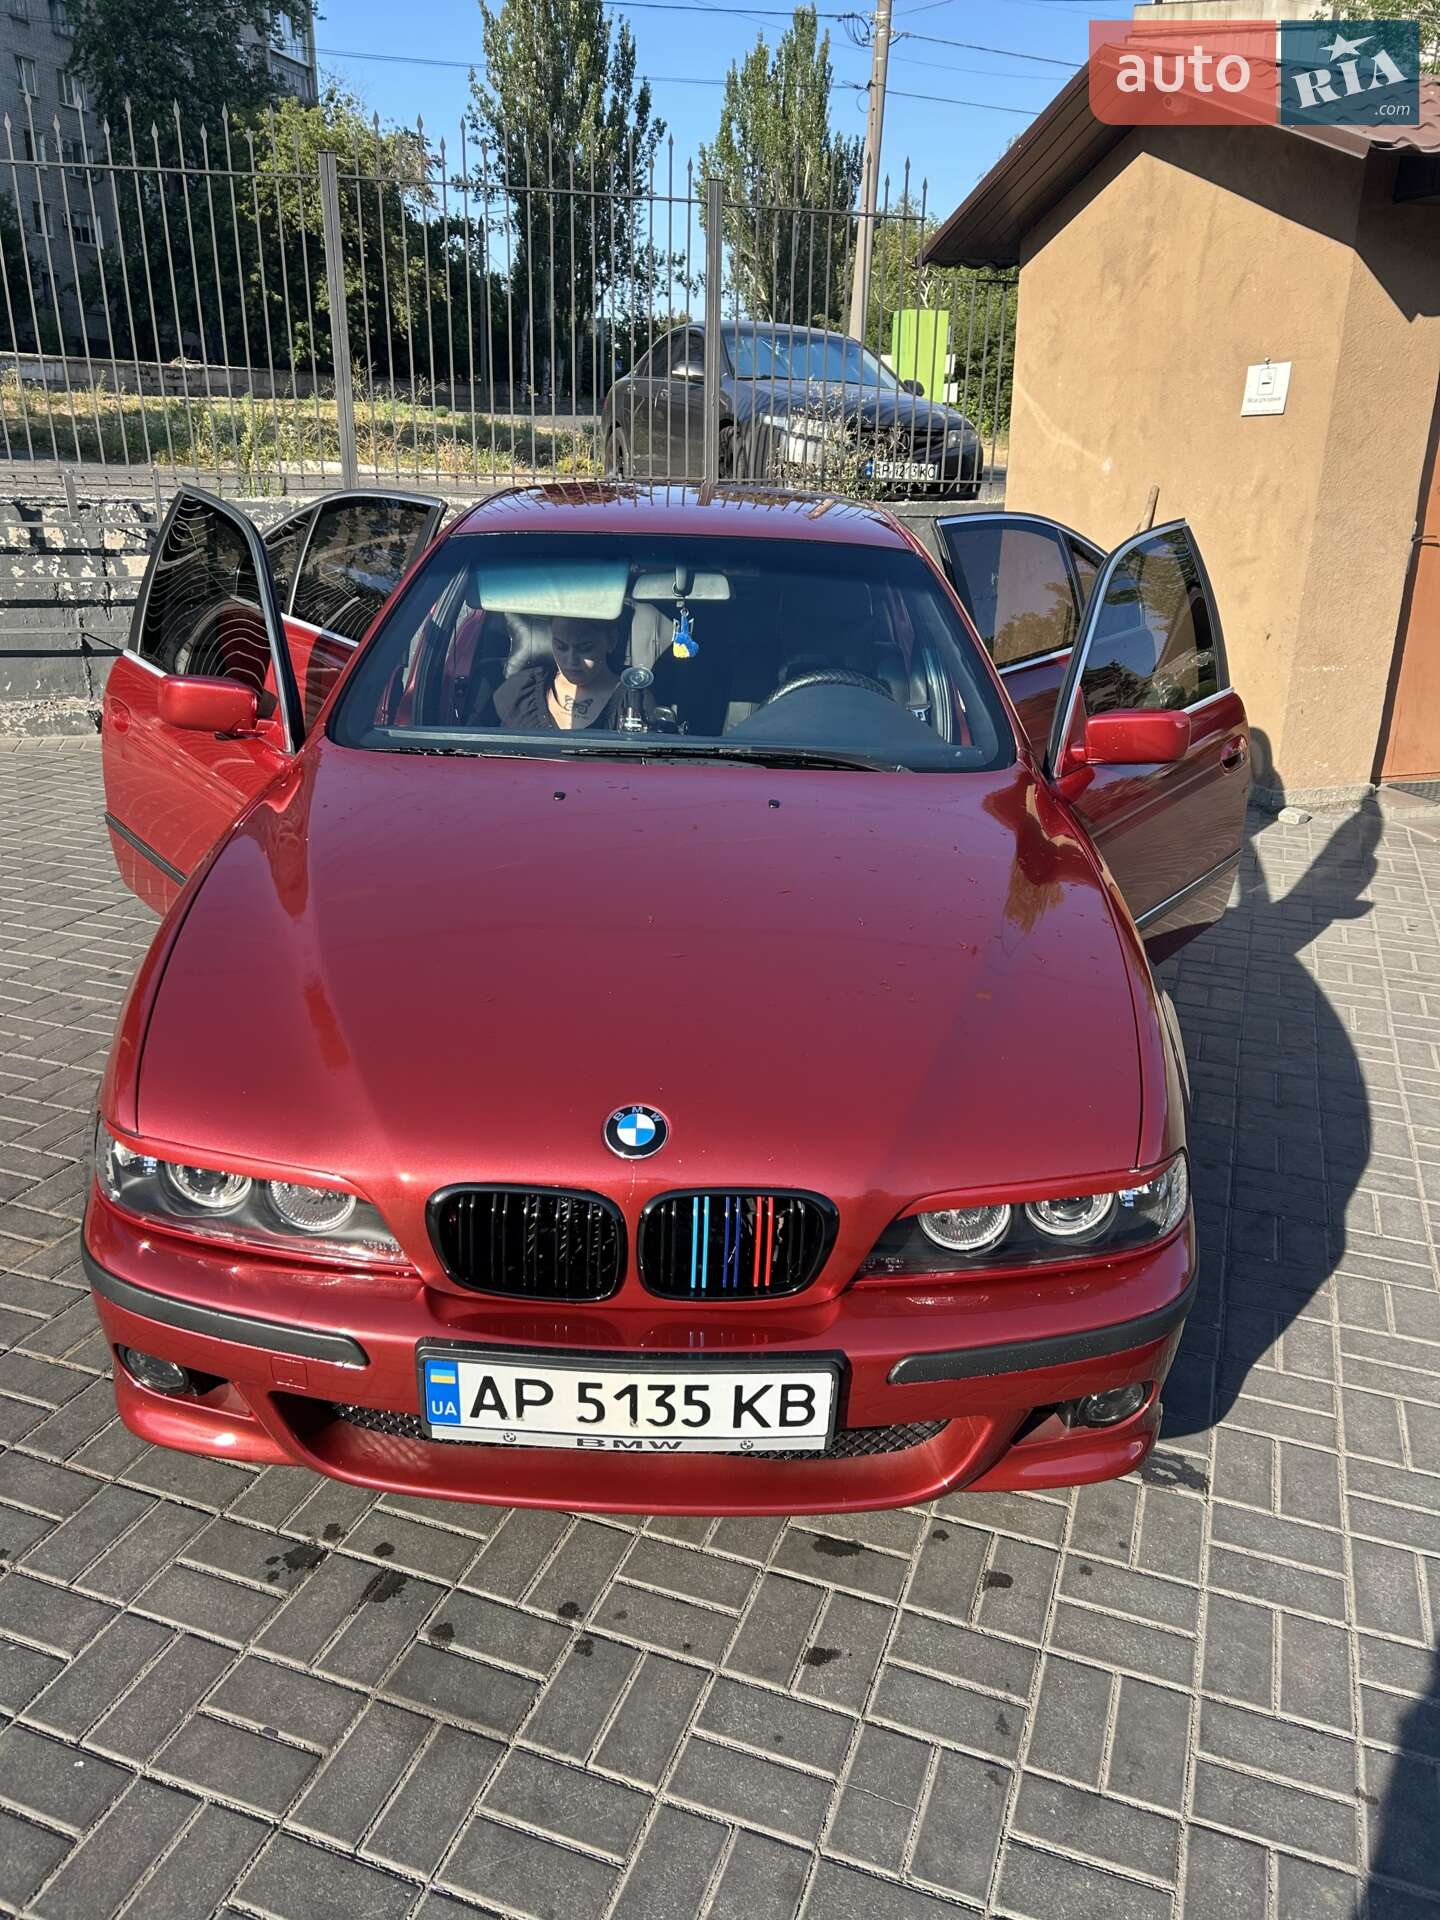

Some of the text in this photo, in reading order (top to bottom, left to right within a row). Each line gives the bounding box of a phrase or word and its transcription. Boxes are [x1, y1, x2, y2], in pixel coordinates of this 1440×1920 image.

[613, 1106, 662, 1122] BMW
[432, 1400, 457, 1416] UA
[470, 1375, 816, 1428] AP 5135 KB
[577, 1438, 683, 1450] BMW
